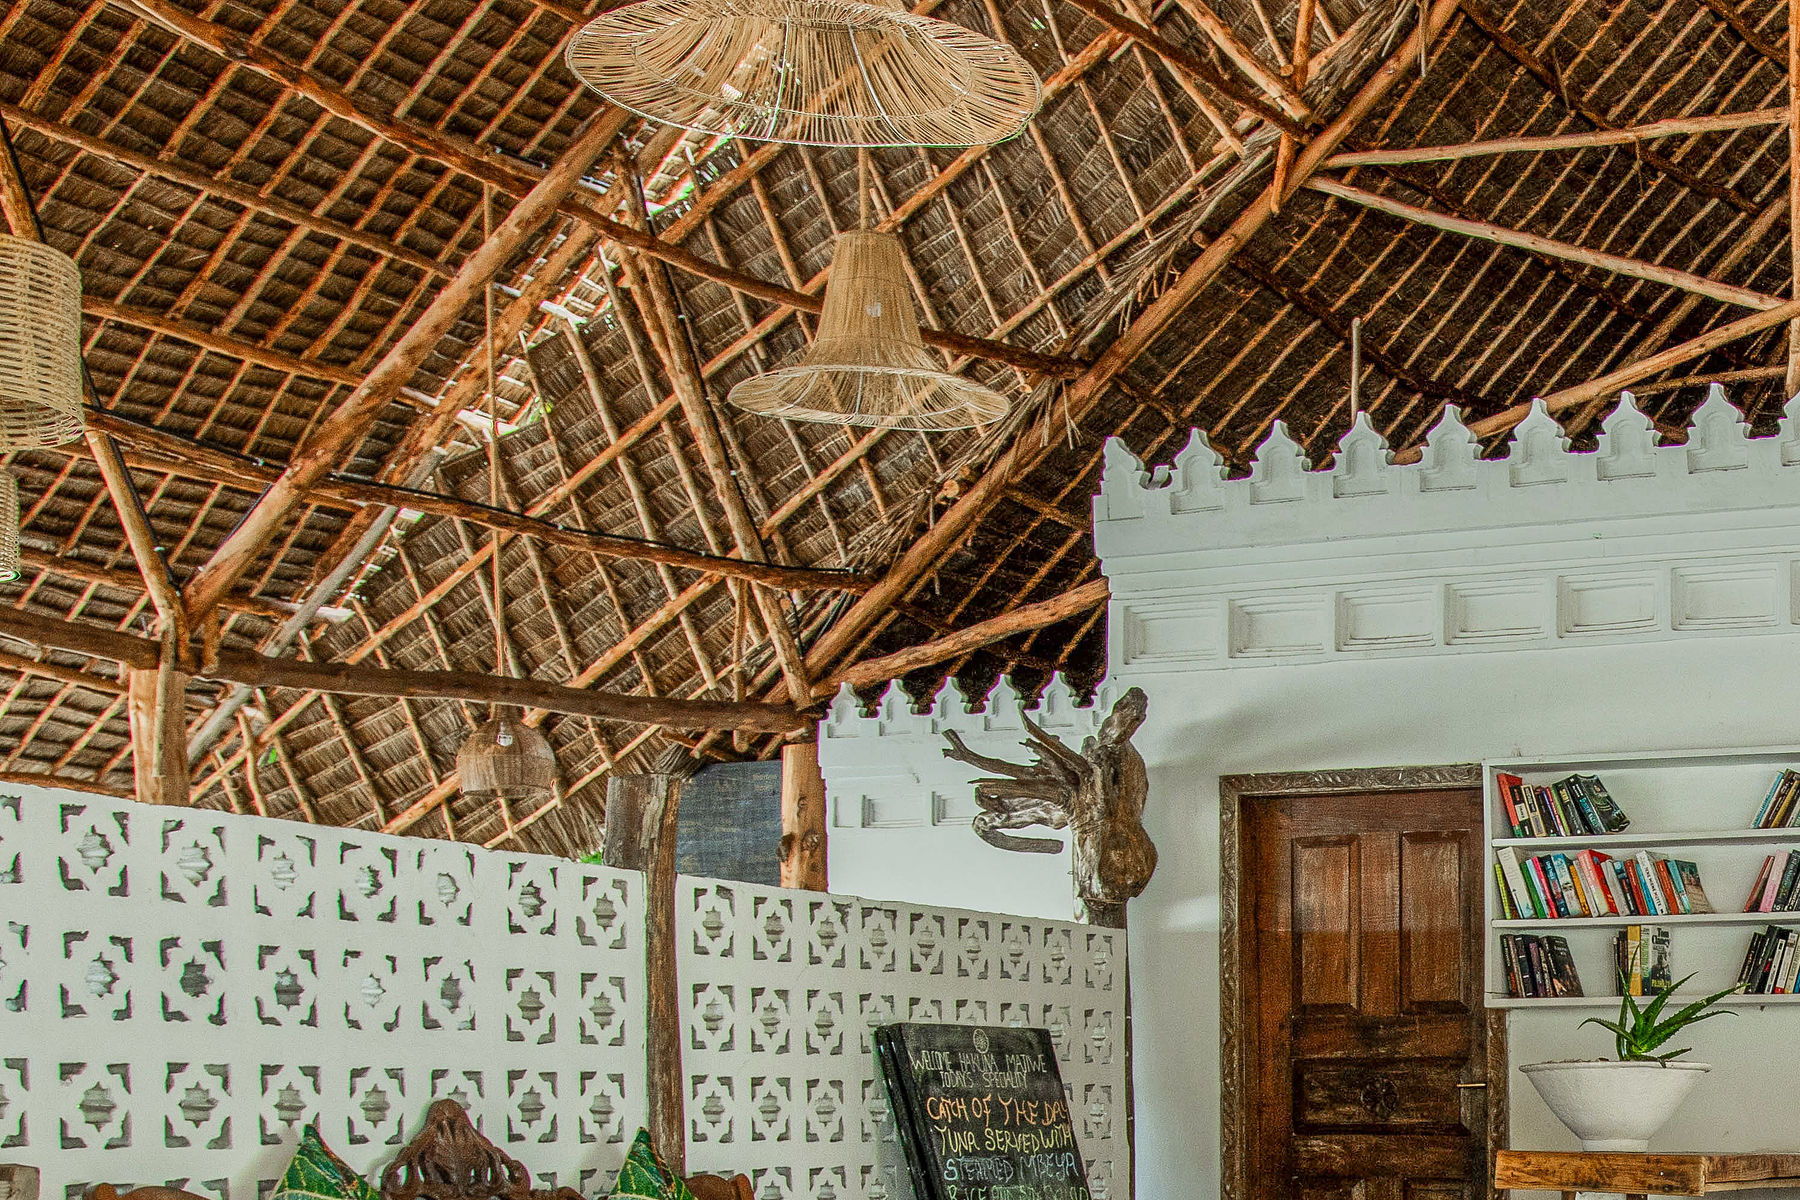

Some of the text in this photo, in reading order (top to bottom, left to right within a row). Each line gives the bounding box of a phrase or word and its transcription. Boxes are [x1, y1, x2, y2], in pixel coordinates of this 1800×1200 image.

[959, 1052, 999, 1072] HAKUNA
[926, 1093, 1069, 1127] CATCH OF THE DAY
[934, 1123, 1074, 1157] TUNA SERVED WITH
[944, 1155, 1014, 1183] STEAMED
